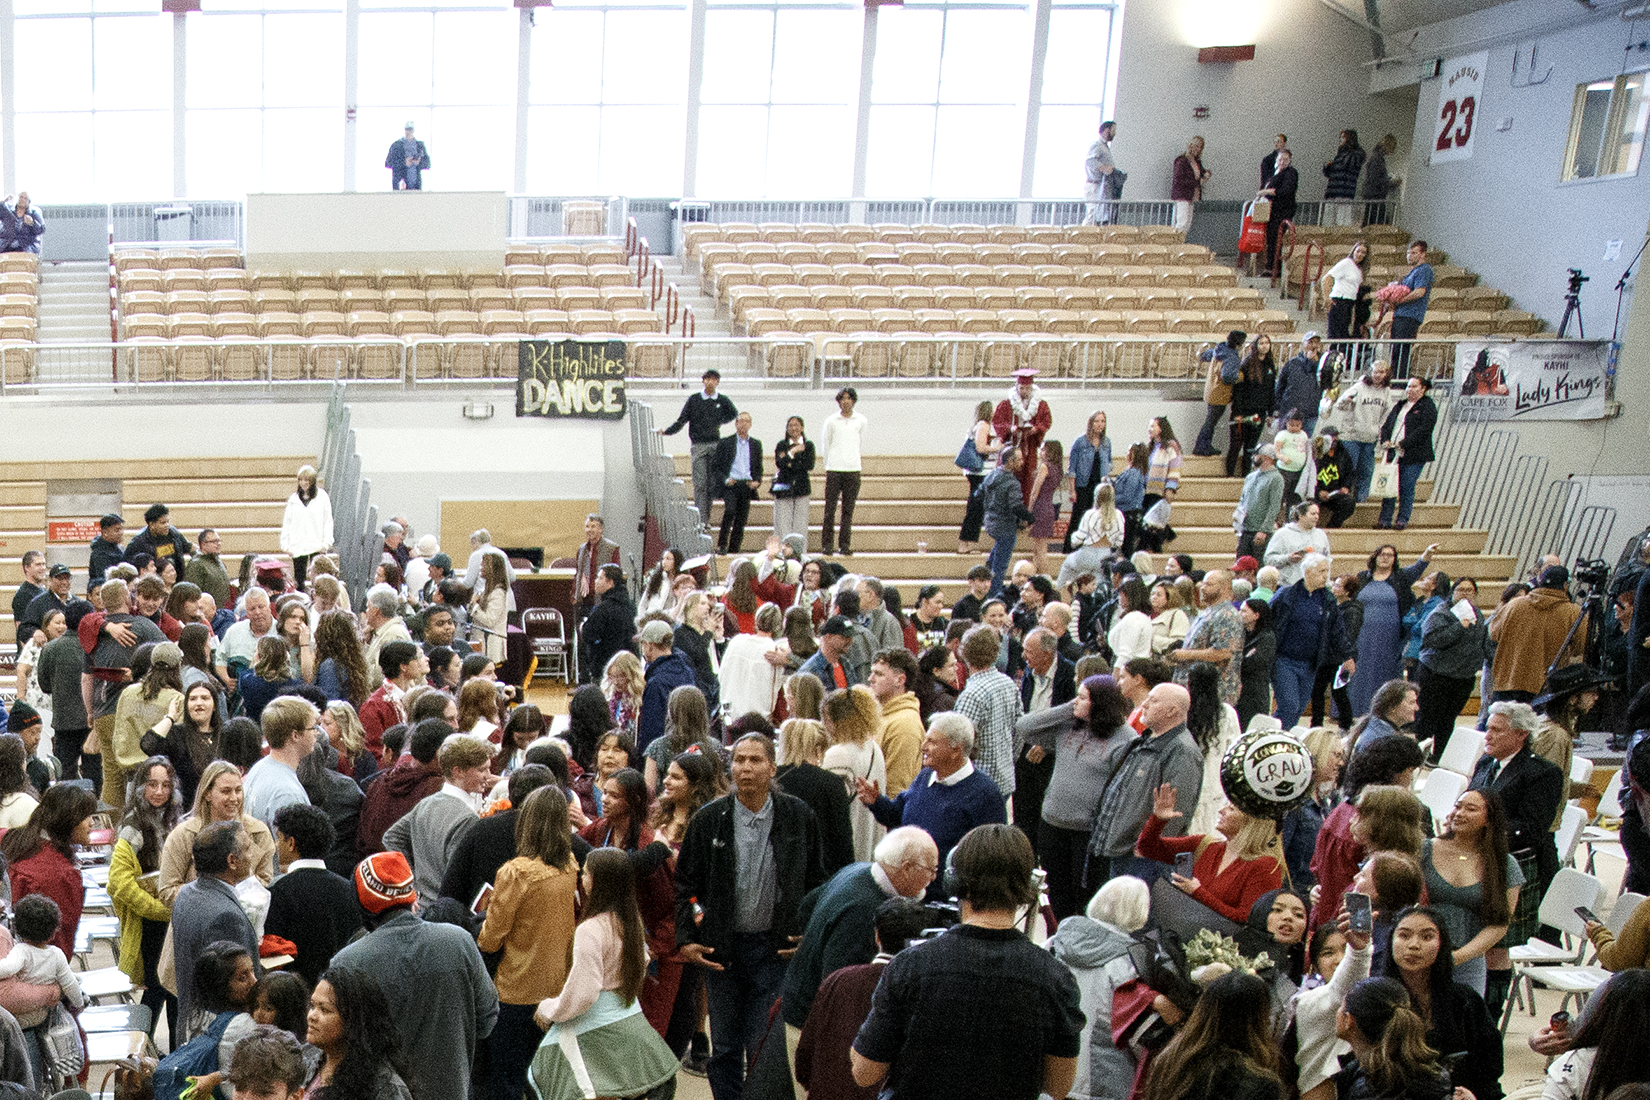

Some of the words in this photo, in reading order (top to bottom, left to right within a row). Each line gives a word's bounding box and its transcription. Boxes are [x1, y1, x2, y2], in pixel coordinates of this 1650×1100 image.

[1436, 96, 1476, 151] 23
[1543, 360, 1569, 371] KAYHI
[523, 378, 625, 415] DANCE
[1488, 398, 1507, 407] FOX
[1515, 377, 1551, 411] Lady
[1554, 372, 1601, 401] Kings
[530, 612, 556, 620] KAYHI
